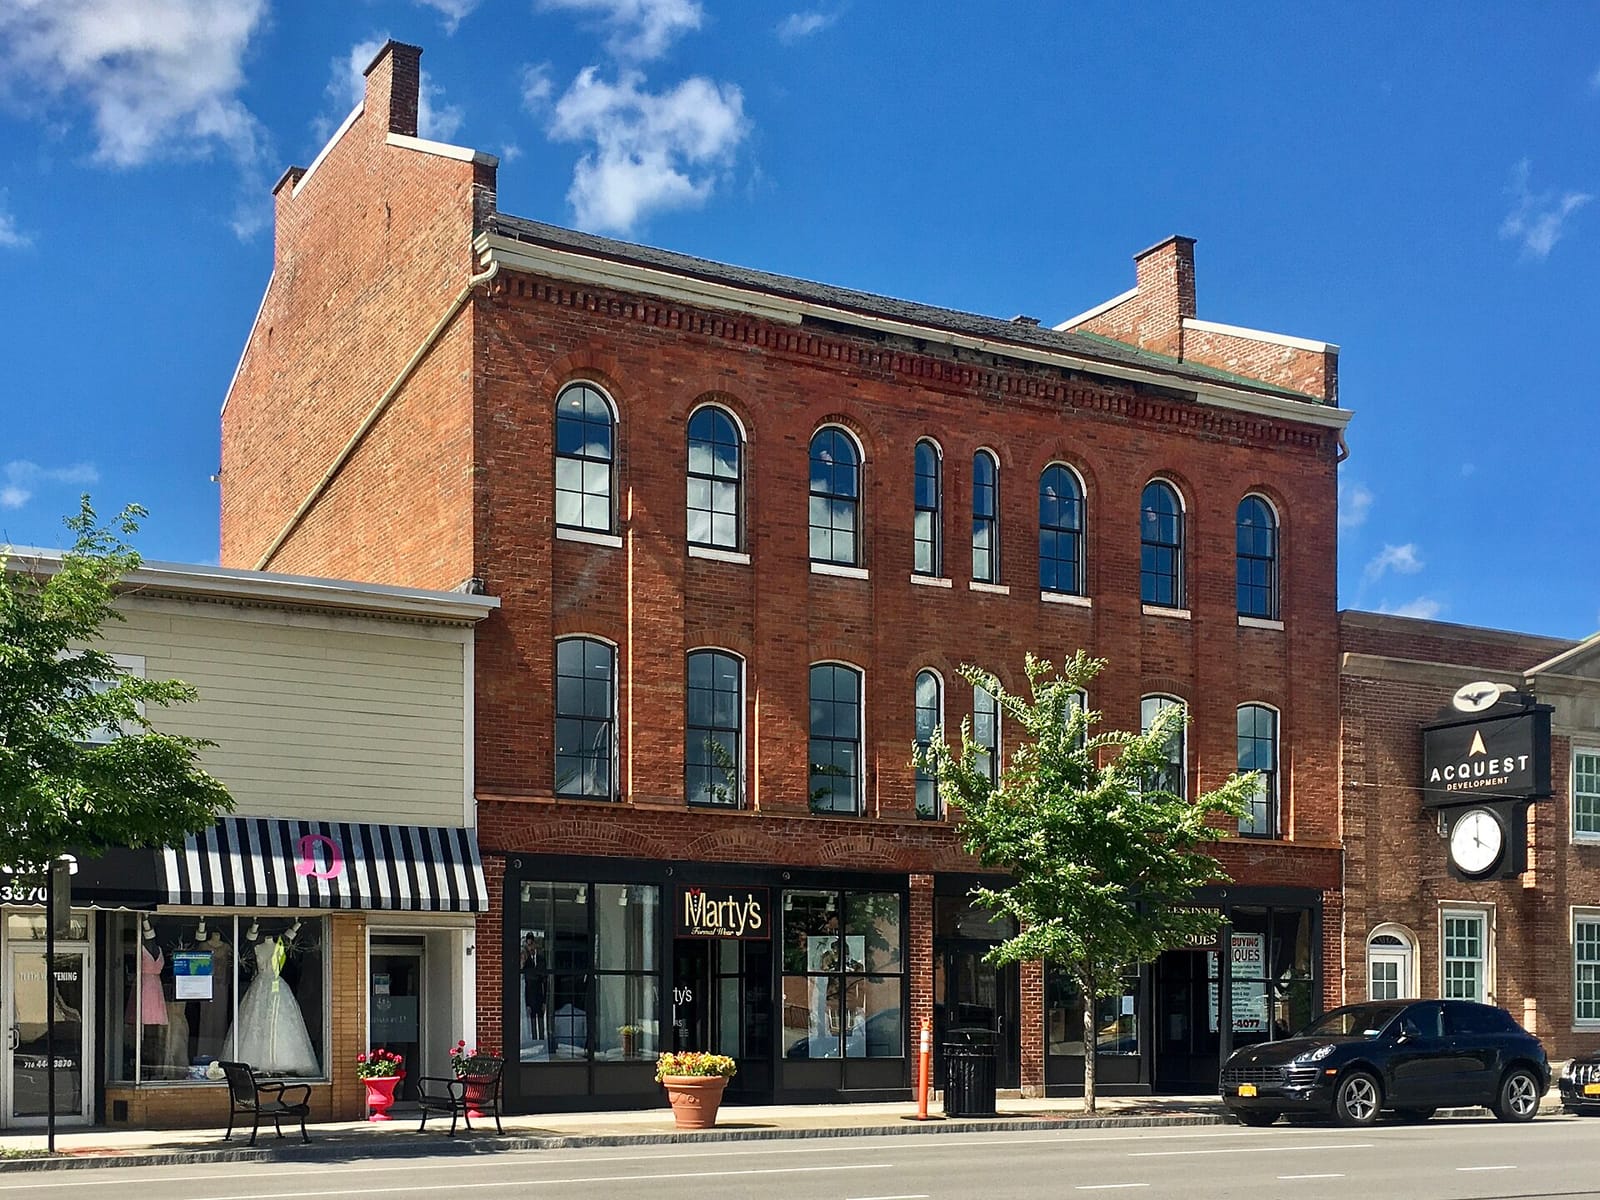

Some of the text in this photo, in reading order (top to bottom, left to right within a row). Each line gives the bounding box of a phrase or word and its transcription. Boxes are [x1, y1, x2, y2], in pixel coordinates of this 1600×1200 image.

[1430, 755, 1528, 782] ACQUEST
[1447, 777, 1508, 791] DEVELOPMENT
[0, 886, 48, 901] 3870
[685, 892, 762, 936] Marty's
[1157, 905, 1220, 915] LESKINNER
[691, 926, 735, 936] Formal Wear
[673, 986, 692, 1005] ty's
